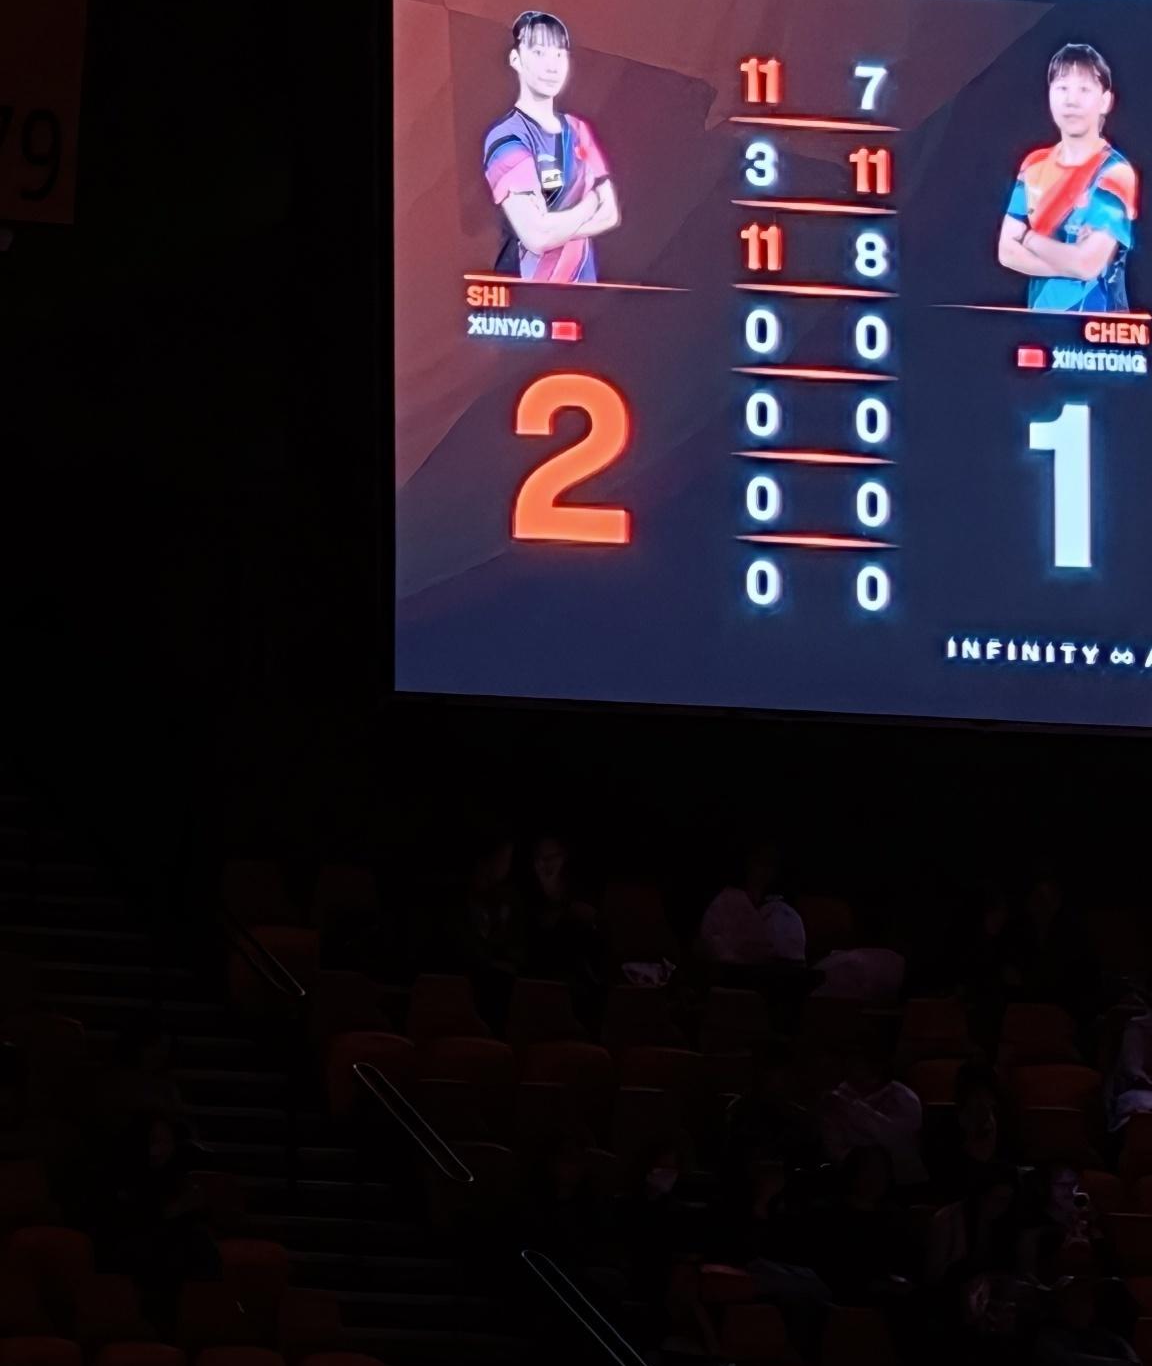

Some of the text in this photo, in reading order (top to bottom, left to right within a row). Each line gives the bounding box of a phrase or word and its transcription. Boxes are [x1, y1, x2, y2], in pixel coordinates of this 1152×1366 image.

[740, 57, 782, 104] 11
[855, 65, 887, 110] 7
[745, 142, 777, 186] 3
[850, 148, 891, 194] 11
[740, 224, 783, 271] 11
[855, 232, 887, 277] 8
[466, 285, 509, 307] SHI
[467, 314, 546, 339] XUNYAO
[746, 309, 778, 353] 0
[856, 315, 888, 360] 0
[1085, 321, 1150, 345] CHEN
[1052, 348, 1148, 373] XINGTONG
[746, 392, 778, 436] 0
[856, 398, 889, 443] 0
[512, 373, 632, 544] 2
[747, 476, 779, 521] 0
[857, 482, 889, 527] 0
[1029, 402, 1092, 568] 1
[747, 560, 779, 605] 0
[857, 566, 889, 611] 0
[947, 636, 1100, 664] INFINITY
